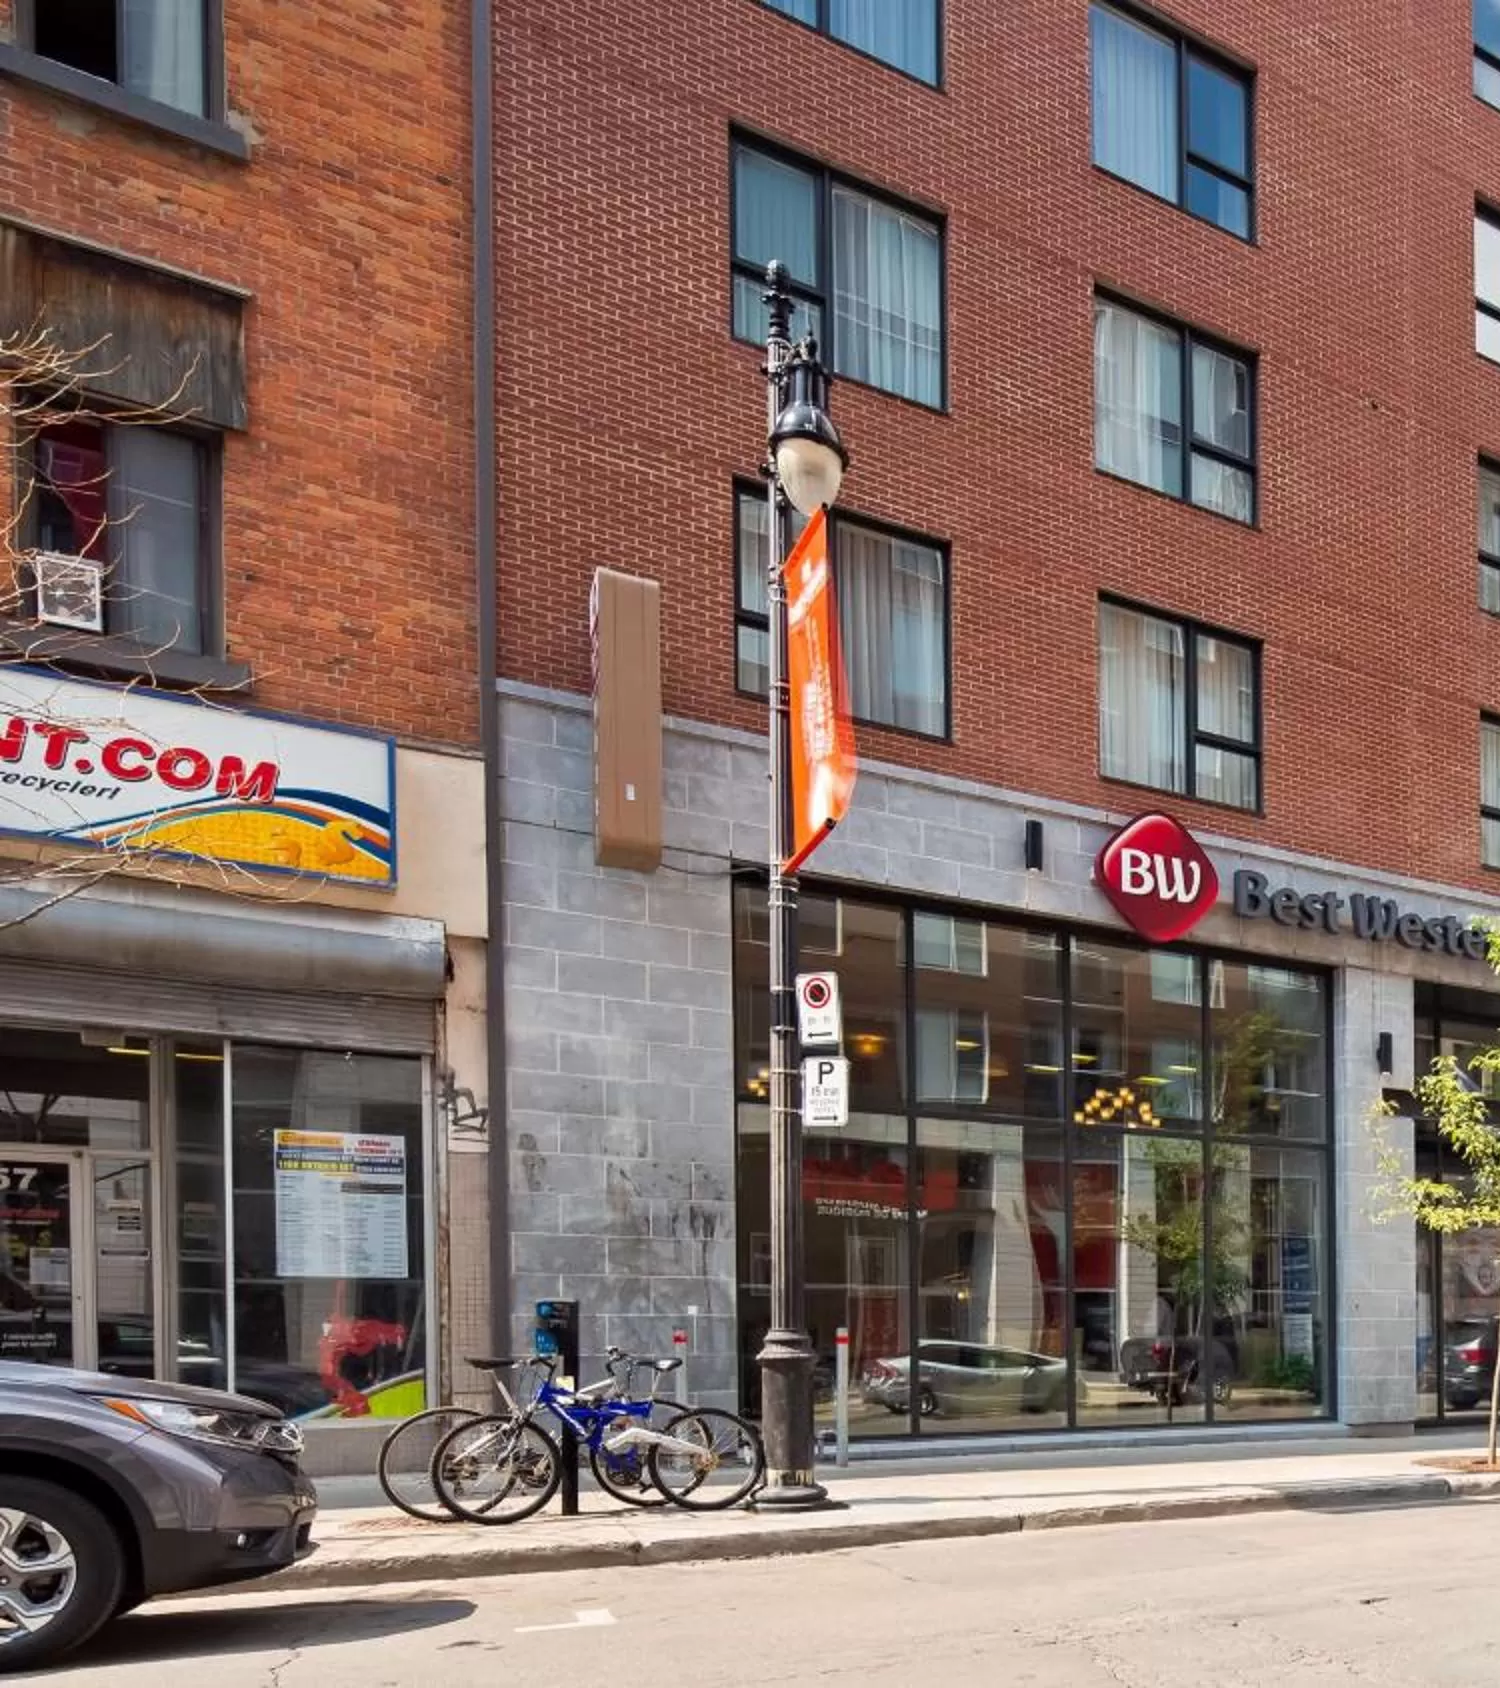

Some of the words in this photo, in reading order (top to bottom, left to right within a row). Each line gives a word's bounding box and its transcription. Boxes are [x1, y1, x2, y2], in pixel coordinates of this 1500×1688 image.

[1120, 847, 1201, 903] BW
[1233, 869, 1340, 935] Best
[1350, 891, 1490, 960] Weste
[818, 1061, 835, 1085] P
